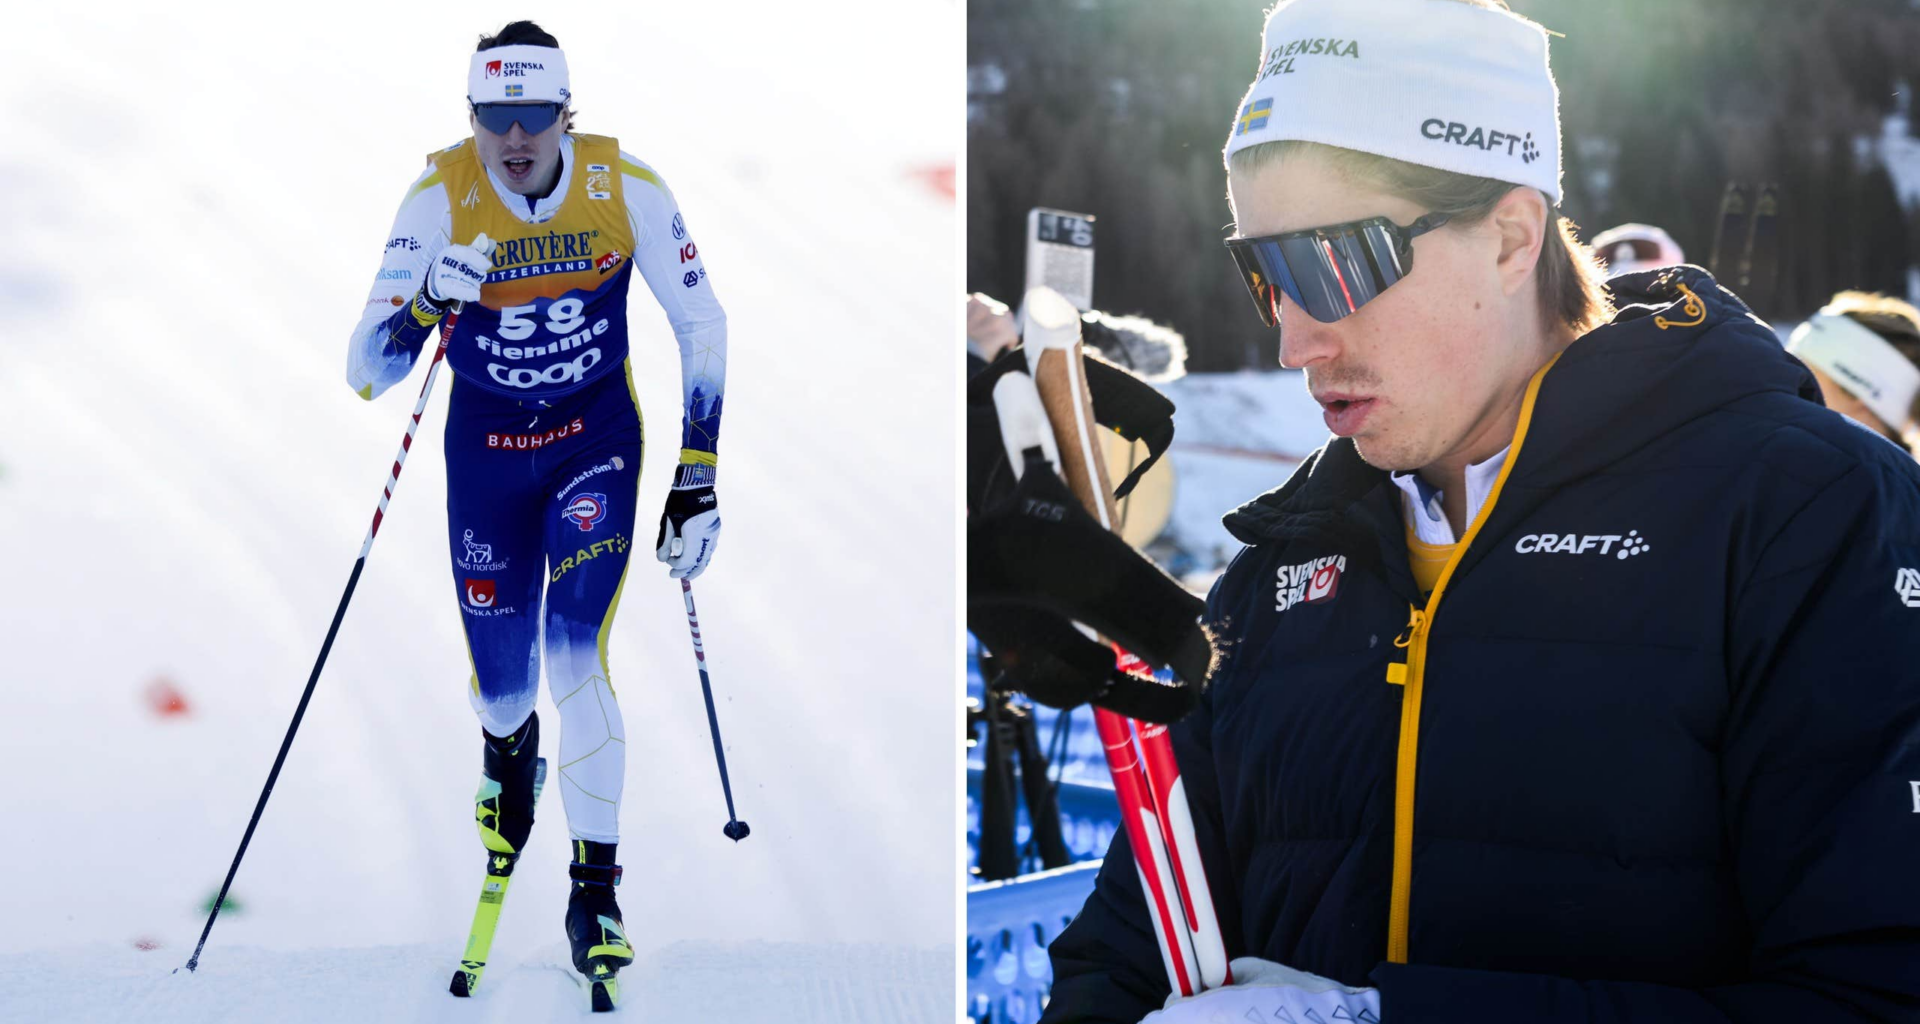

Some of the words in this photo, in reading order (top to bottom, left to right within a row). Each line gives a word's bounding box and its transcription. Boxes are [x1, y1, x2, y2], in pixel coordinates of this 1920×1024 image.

[1267, 38, 1359, 65] SVENSKA
[503, 69, 526, 77] SPEL
[504, 62, 545, 71] SVENSKA
[1421, 118, 1521, 155] CRAFT
[491, 261, 587, 282] ITZERLAND
[487, 347, 602, 389] coop
[488, 418, 583, 449] BAUHAUS
[556, 462, 612, 501] Sundström
[562, 504, 595, 519] Thermia
[1514, 533, 1622, 555] CRAFT
[472, 561, 507, 571] nordisk
[552, 538, 615, 582] CRAFT
[1276, 554, 1347, 588] SVENSKA
[493, 606, 516, 616] SPEL
